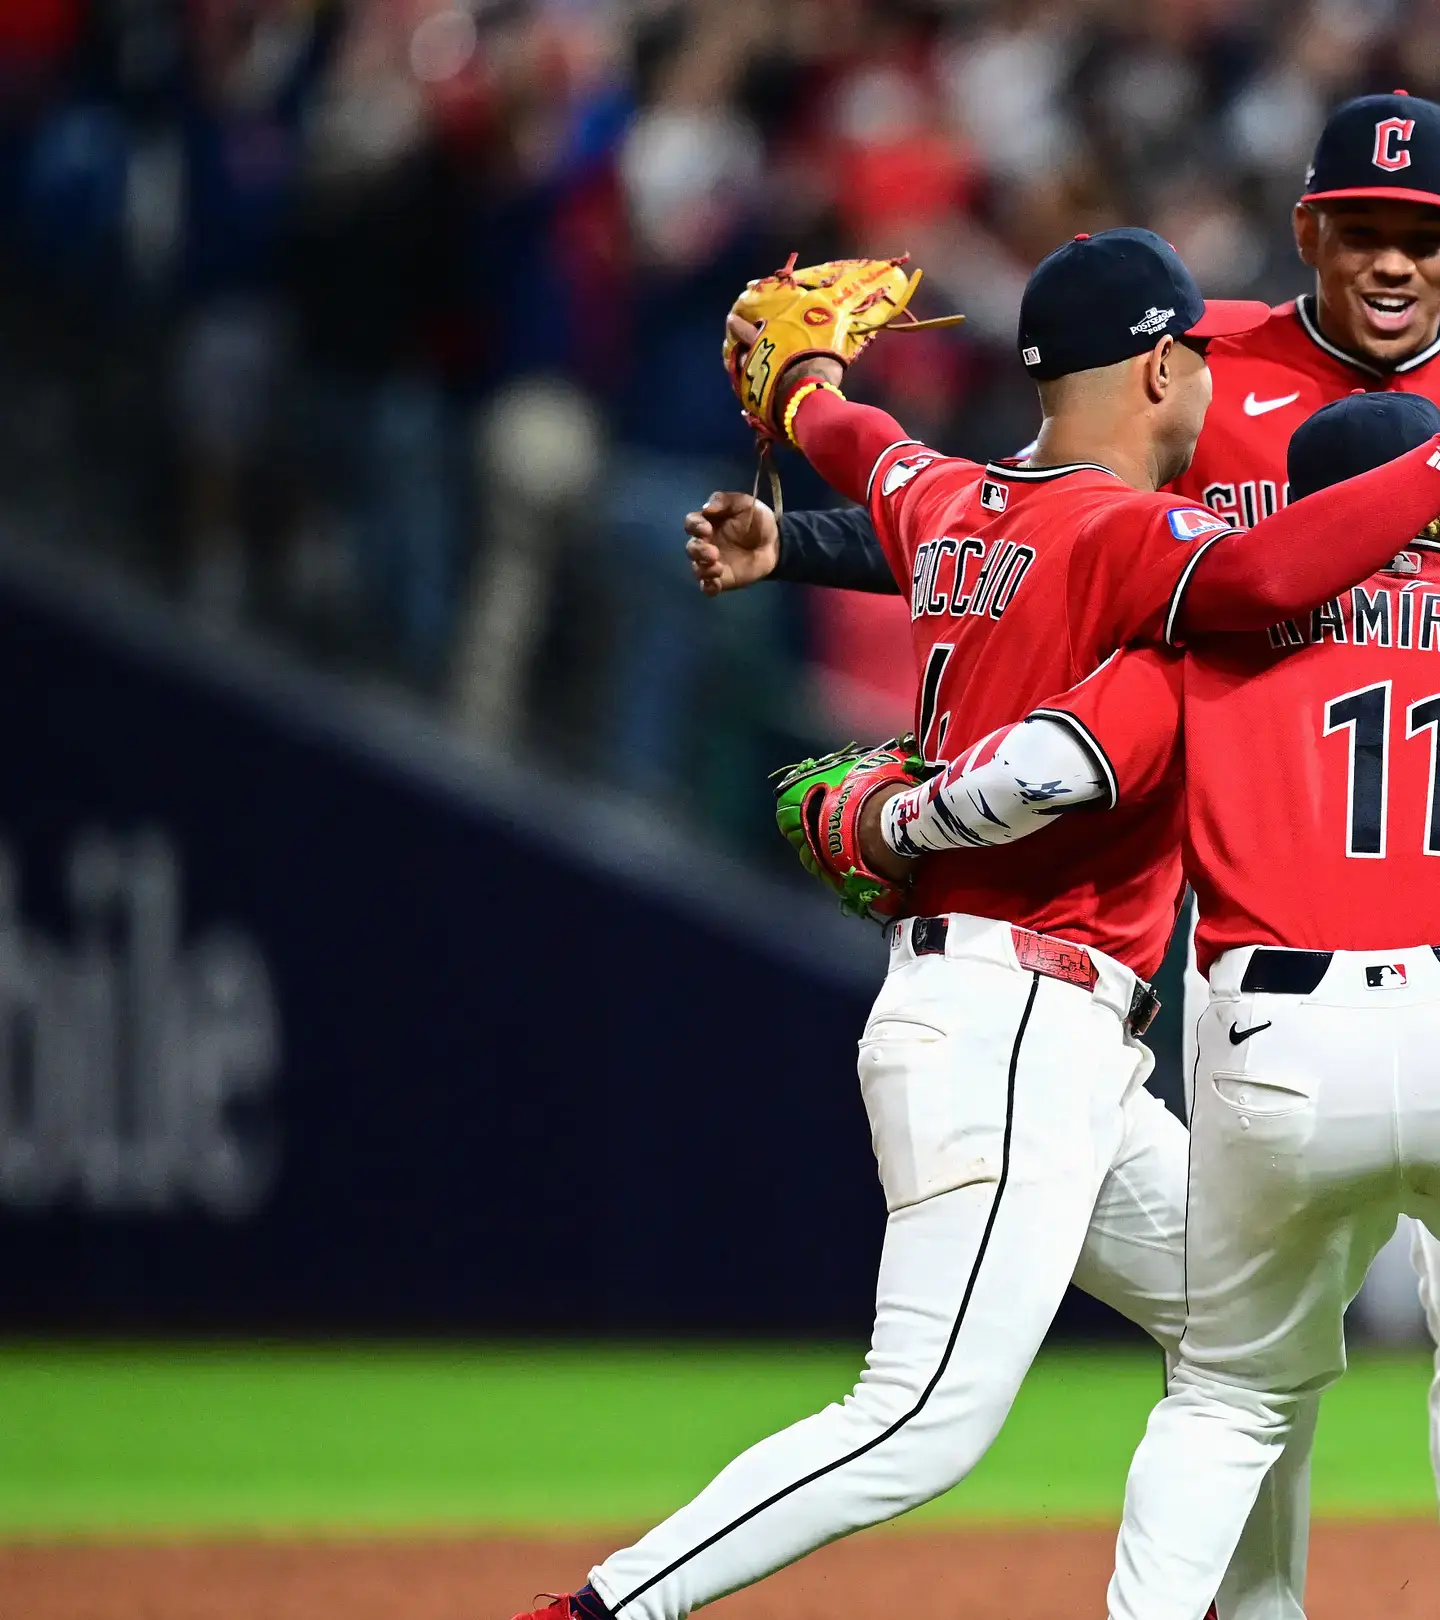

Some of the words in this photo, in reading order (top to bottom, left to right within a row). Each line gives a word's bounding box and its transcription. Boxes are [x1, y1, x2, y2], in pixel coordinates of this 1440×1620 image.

[1371, 116, 1416, 172] C
[1129, 308, 1176, 336] POSTSEASON
[827, 784, 855, 857] Wilson
